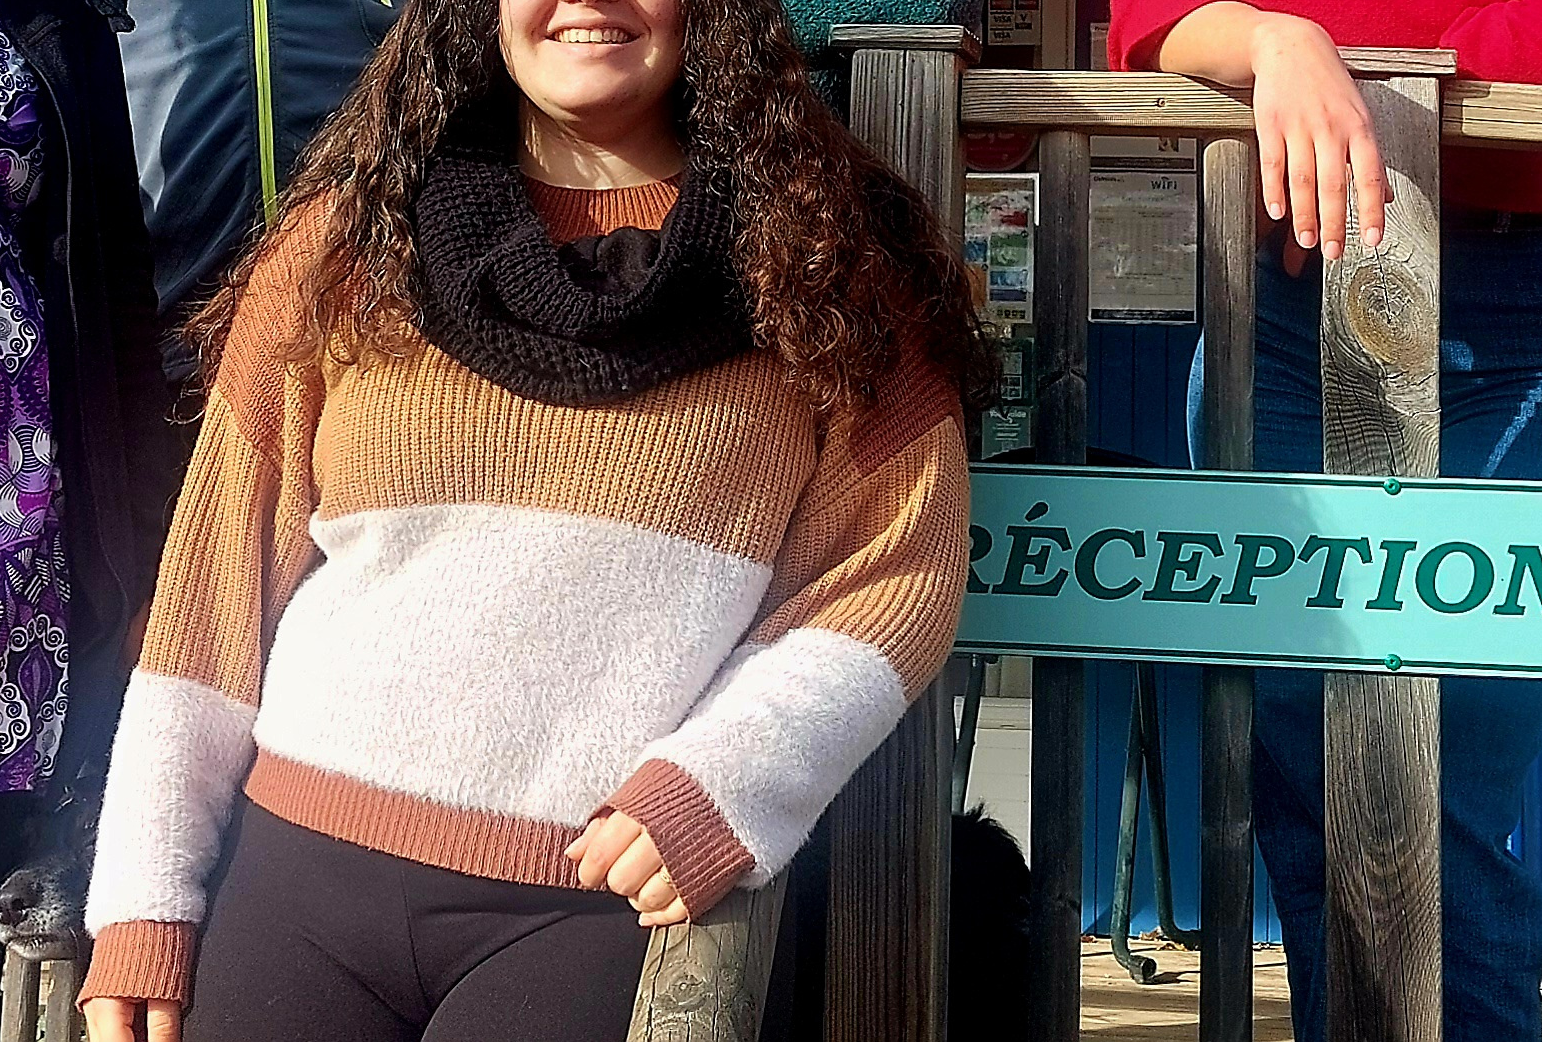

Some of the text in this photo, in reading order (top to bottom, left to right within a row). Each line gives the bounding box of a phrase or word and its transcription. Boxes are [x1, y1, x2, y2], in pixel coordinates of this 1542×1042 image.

[993, 15, 1012, 23] VISA
[993, 31, 1011, 39] VISA
[1151, 178, 1178, 190] WiFi
